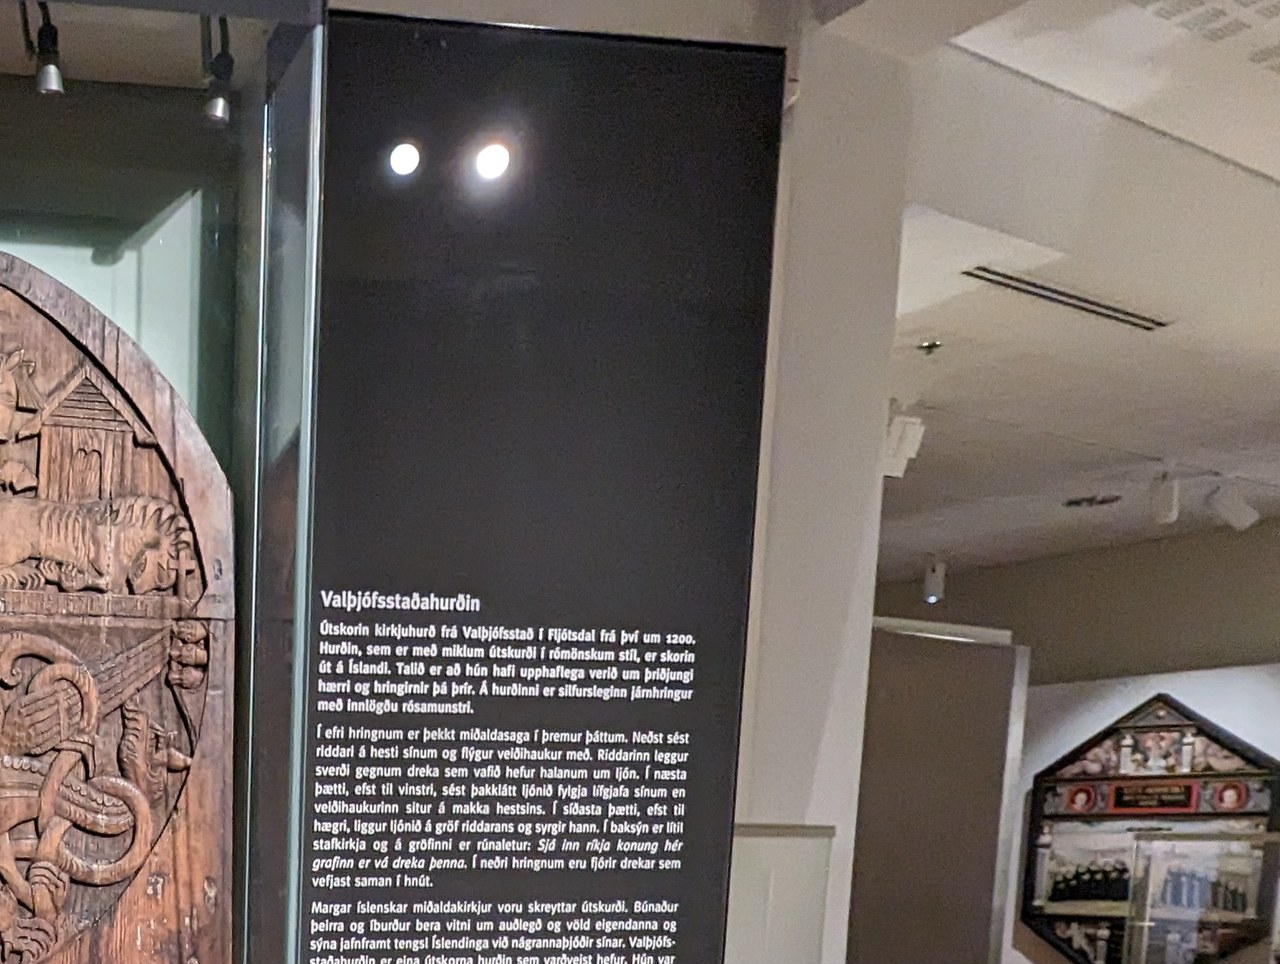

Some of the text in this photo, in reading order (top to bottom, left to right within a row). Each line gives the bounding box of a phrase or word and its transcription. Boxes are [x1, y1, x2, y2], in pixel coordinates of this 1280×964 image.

[320, 621, 370, 636] Útskorin
[374, 623, 436, 640] kirkjuhurð
[441, 625, 458, 639] frá
[463, 626, 535, 642] Valþjófsstað
[548, 628, 596, 644] Fljótsdal
[600, 629, 617, 643] frá
[620, 630, 639, 646] því
[643, 633, 661, 644] um
[666, 634, 696, 645] 1200.
[320, 641, 363, 657] Hurðin,
[366, 645, 391, 656] sem
[395, 646, 409, 657] er
[412, 643, 438, 657] með
[442, 644, 485, 658] miklum
[489, 645, 537, 659] útskurði
[549, 647, 615, 661] rómönskum
[618, 648, 641, 663] stíl,
[644, 652, 658, 662] er
[660, 650, 695, 663] skorin
[317, 698, 474, 715] með innlögðu rósamunstri.
[316, 744, 689, 765] riddari á hesti sínum og flýgur veiðihaukur með. Riddarinn leggur
[315, 782, 686, 800] þætti, efst til vinstri, sést þakklátt ljónið fylgja lífgjafa sínum en
[312, 874, 351, 890] vefjast
[354, 877, 392, 887] saman
[404, 874, 434, 887] hnút.
[311, 901, 352, 916] Margar
[357, 901, 408, 914] íslenskar
[497, 903, 523, 913] voru
[528, 901, 577, 916] skreyttar
[581, 900, 629, 913] útskurði.
[634, 900, 679, 913] Búnaður
[632, 953, 654, 964] Hún
[658, 956, 676, 964] var
